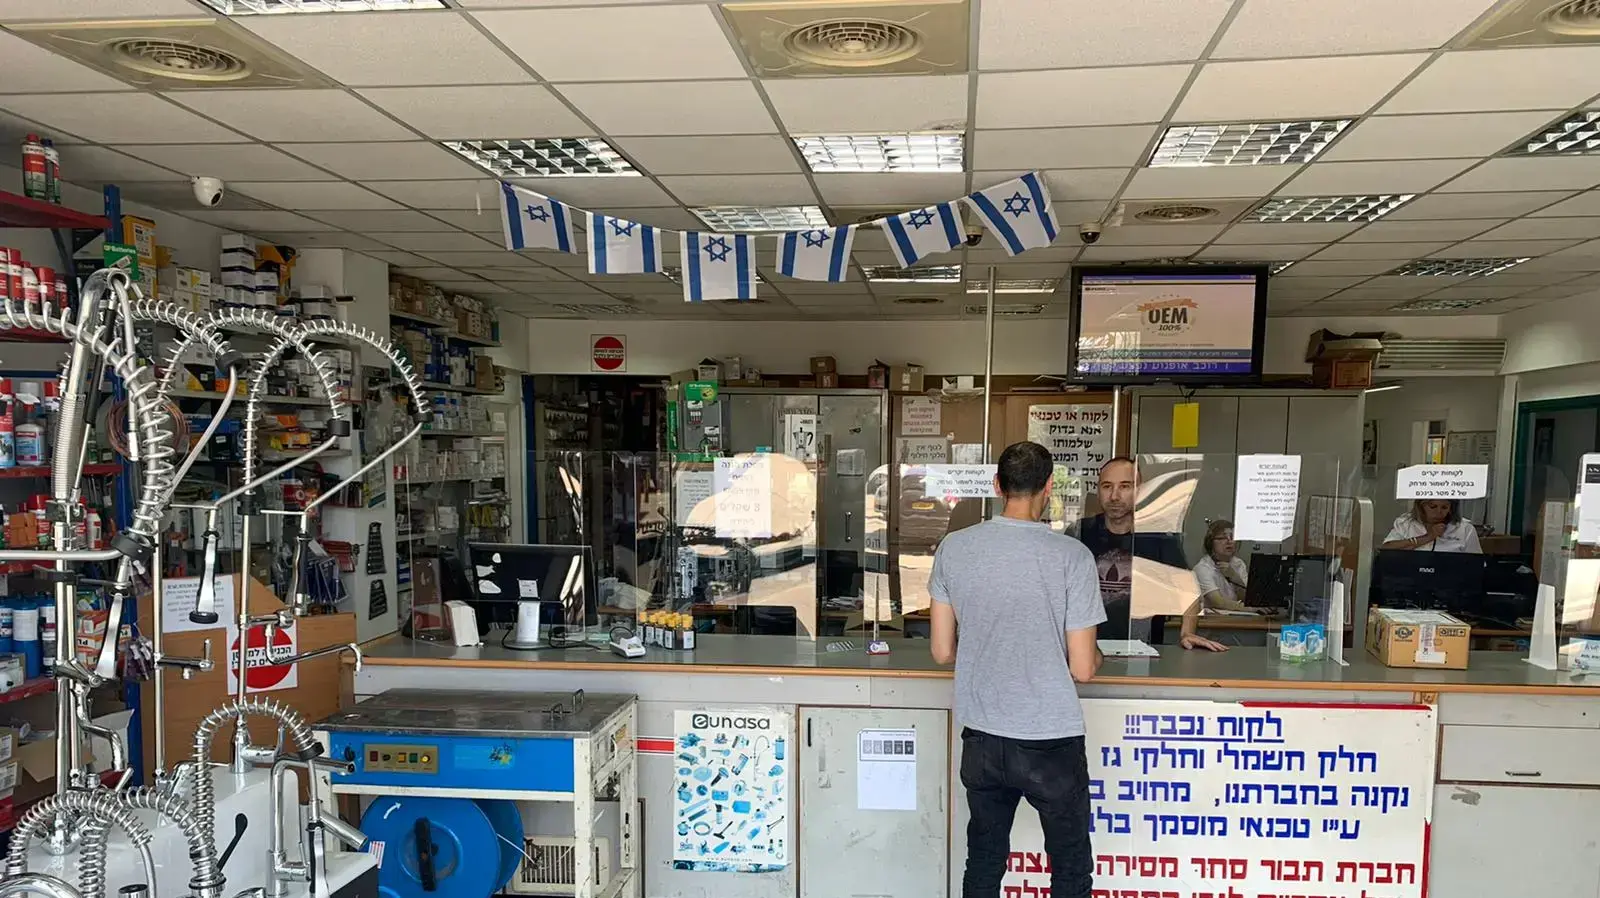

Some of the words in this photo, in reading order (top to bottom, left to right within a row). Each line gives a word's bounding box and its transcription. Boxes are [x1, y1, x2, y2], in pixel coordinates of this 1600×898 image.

[1148, 307, 1188, 324] OEM
[1066, 411, 1077, 420] או
[1082, 410, 1109, 423] לקוח
[1049, 424, 1075, 435] בדוק
[1081, 426, 1102, 435] אנא
[1053, 438, 1093, 448] שלמותו
[1052, 453, 1078, 462] המוצ
[1087, 451, 1104, 462] של
[692, 713, 771, 730] eunasa
[1125, 714, 1205, 737] נכבד!!!
[1216, 711, 1283, 743] לקוח
[1101, 747, 1121, 767] גז
[1134, 741, 1205, 774] וחלקי
[1217, 743, 1304, 773] חשמלי
[1318, 745, 1377, 778] חלק
[1118, 780, 1191, 802] מחויב
[1351, 785, 1409, 813] נקנה
[1144, 814, 1227, 841] מוסמך
[1240, 817, 1310, 838] טכנאי
[1097, 855, 1178, 878] מסירה
[1191, 857, 1248, 880] סחר
[1261, 859, 1323, 882] תבור
[1336, 861, 1415, 884] חברת
